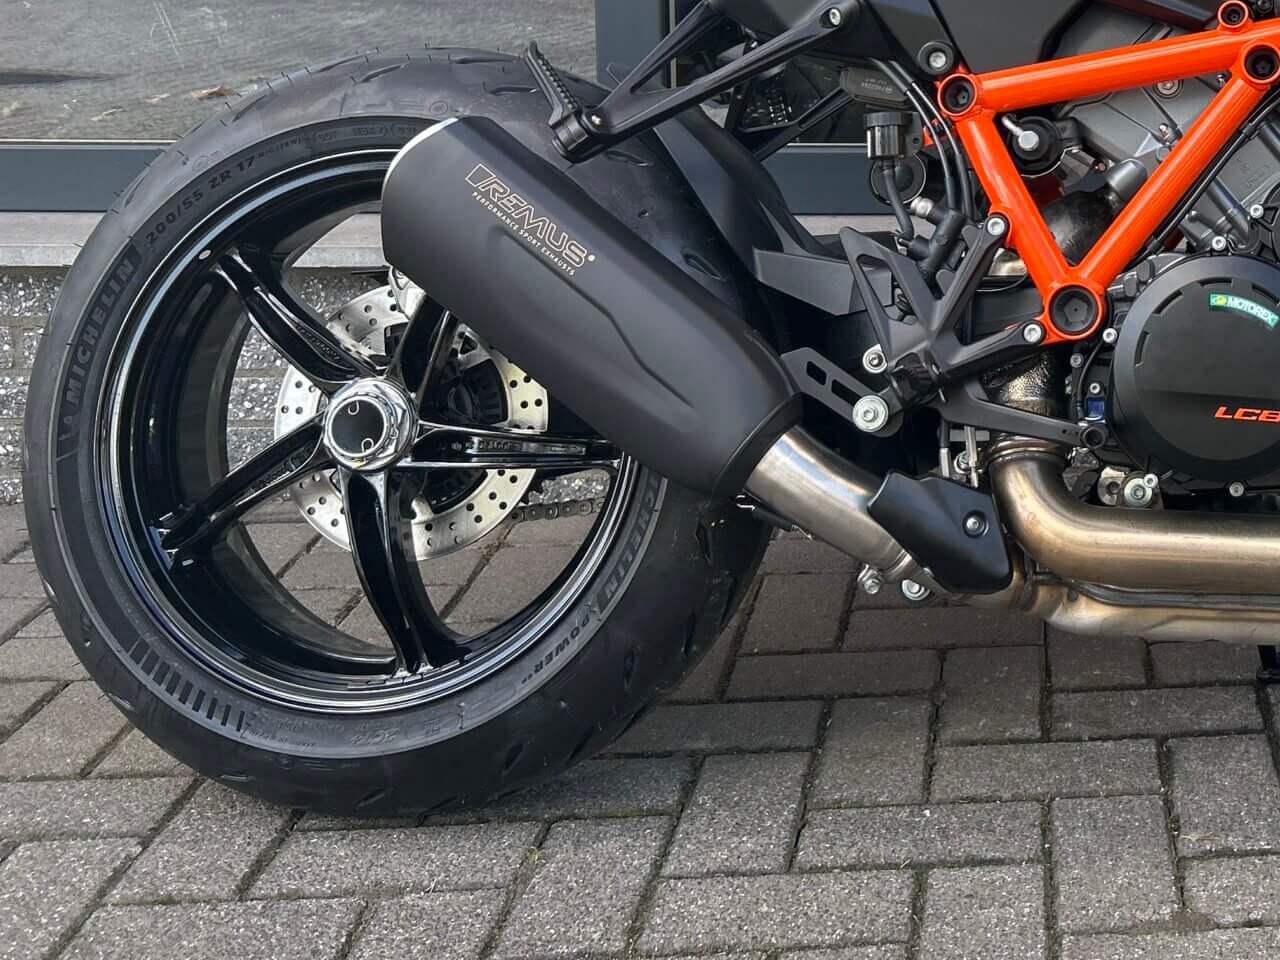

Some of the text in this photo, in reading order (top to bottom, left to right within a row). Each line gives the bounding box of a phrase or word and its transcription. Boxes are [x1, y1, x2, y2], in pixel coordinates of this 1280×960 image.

[145, 190, 204, 243] 200/55
[208, 168, 232, 189] ZR
[236, 155, 257, 172] 17
[471, 191, 576, 276] PERFORMANCE SPORT EXHAUSTS
[480, 177, 587, 268] REMUS
[65, 261, 137, 406] MICHELIN
[1227, 296, 1276, 322] MOTOREX
[604, 475, 661, 599] ICHELIN
[533, 614, 591, 674] POWER
